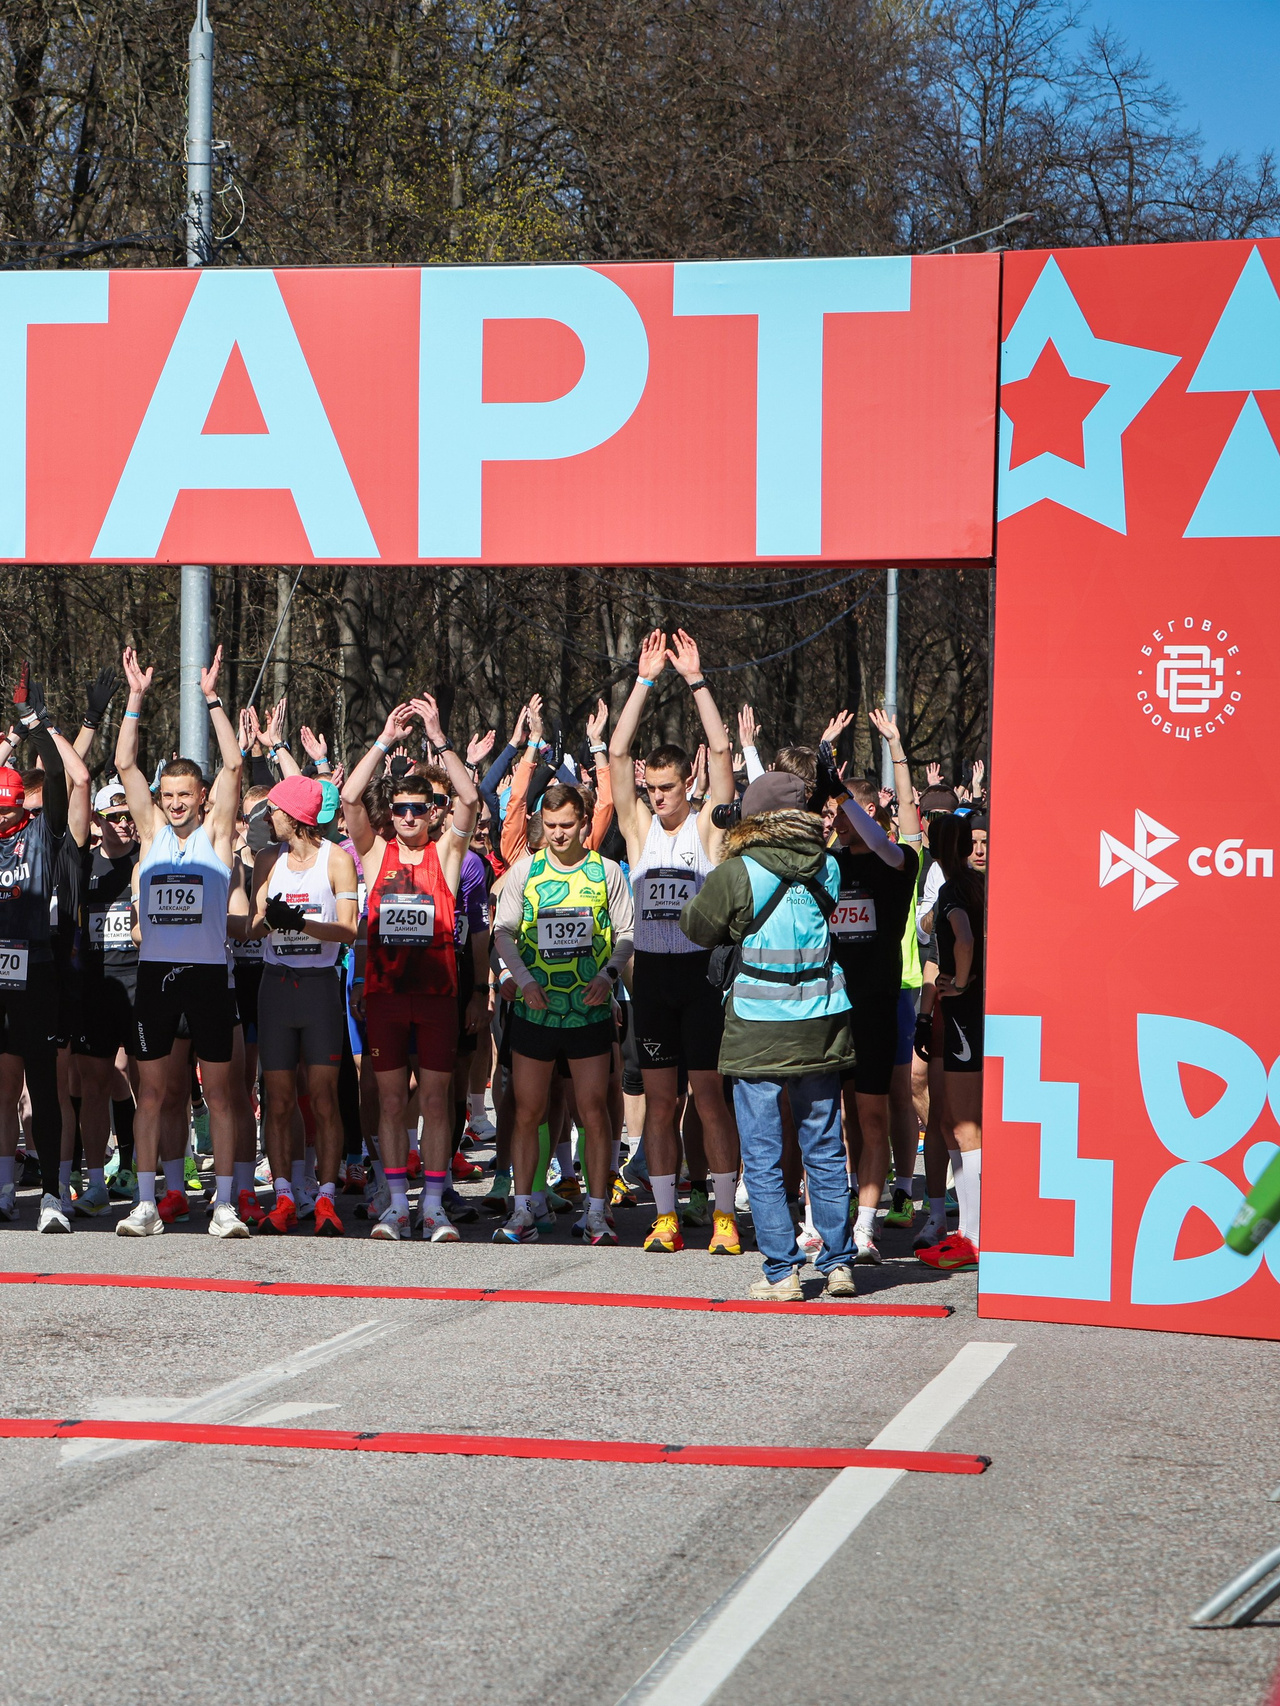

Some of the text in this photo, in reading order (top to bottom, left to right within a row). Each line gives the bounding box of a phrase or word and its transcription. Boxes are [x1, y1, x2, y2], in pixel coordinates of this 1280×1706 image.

[1141, 617, 1239, 656] БЕГОВОЕ
[1137, 691, 1241, 741] СООБЩЕСТВО
[1188, 839, 1273, 877] сбп
[157, 889, 195, 904] 1196
[650, 883, 689, 900] 2114
[386, 909, 427, 925] 2450
[830, 907, 869, 924] 6754
[95, 917, 131, 932] 2165
[545, 922, 586, 939] 1392
